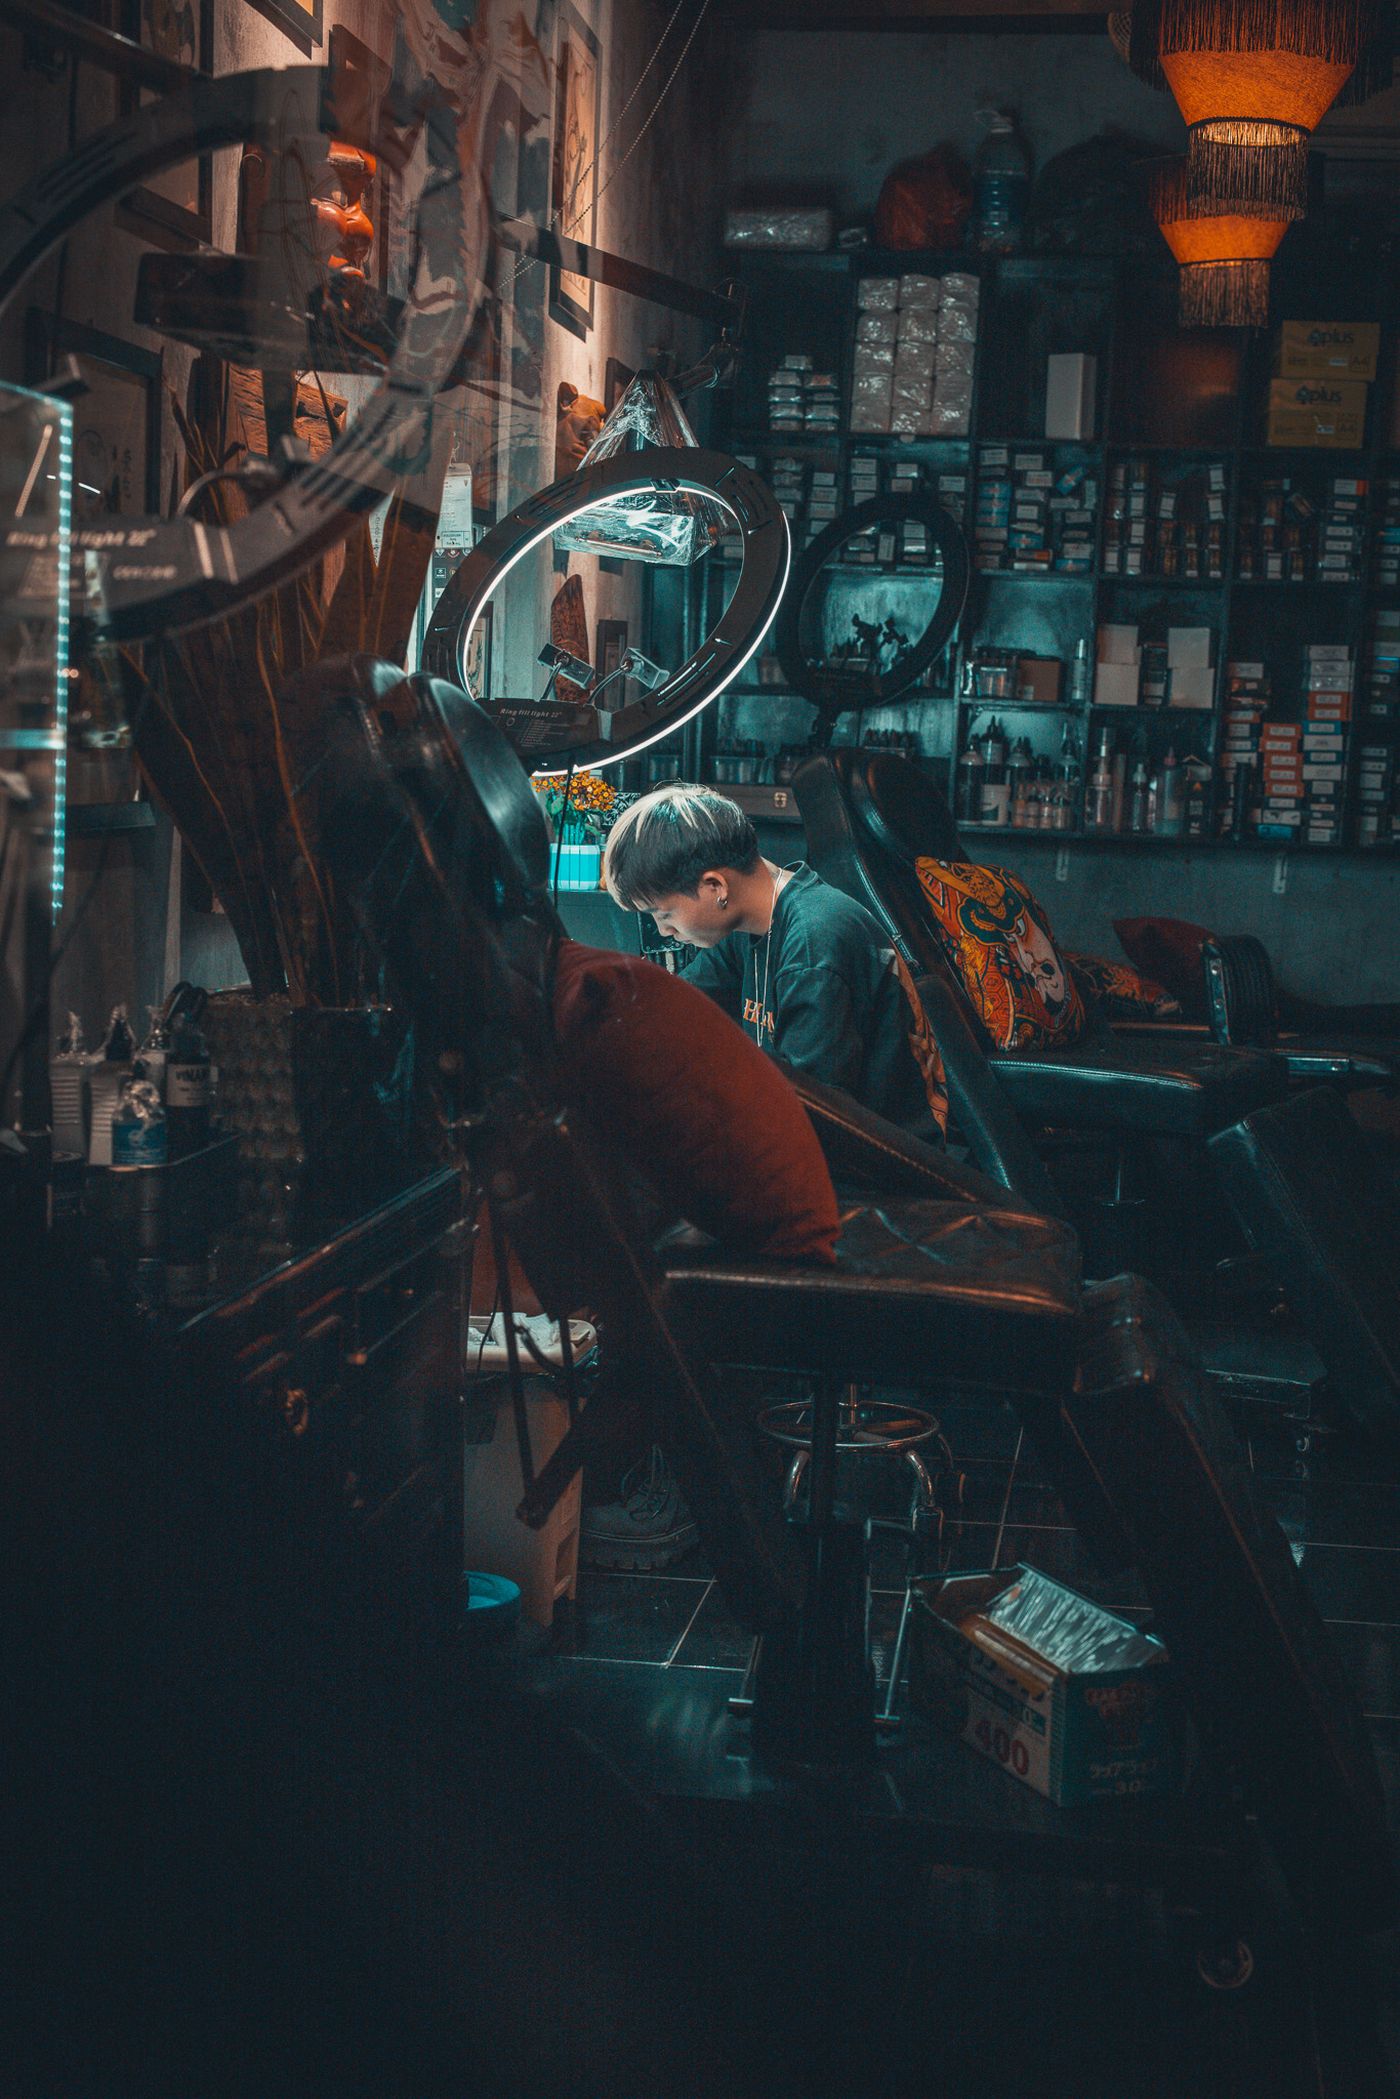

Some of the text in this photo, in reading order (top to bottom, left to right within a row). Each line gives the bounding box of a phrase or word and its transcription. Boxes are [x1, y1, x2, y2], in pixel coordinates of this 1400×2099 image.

[499, 708, 518, 717] Ring
[530, 709, 550, 718] light
[975, 1719, 1030, 1776] 400
